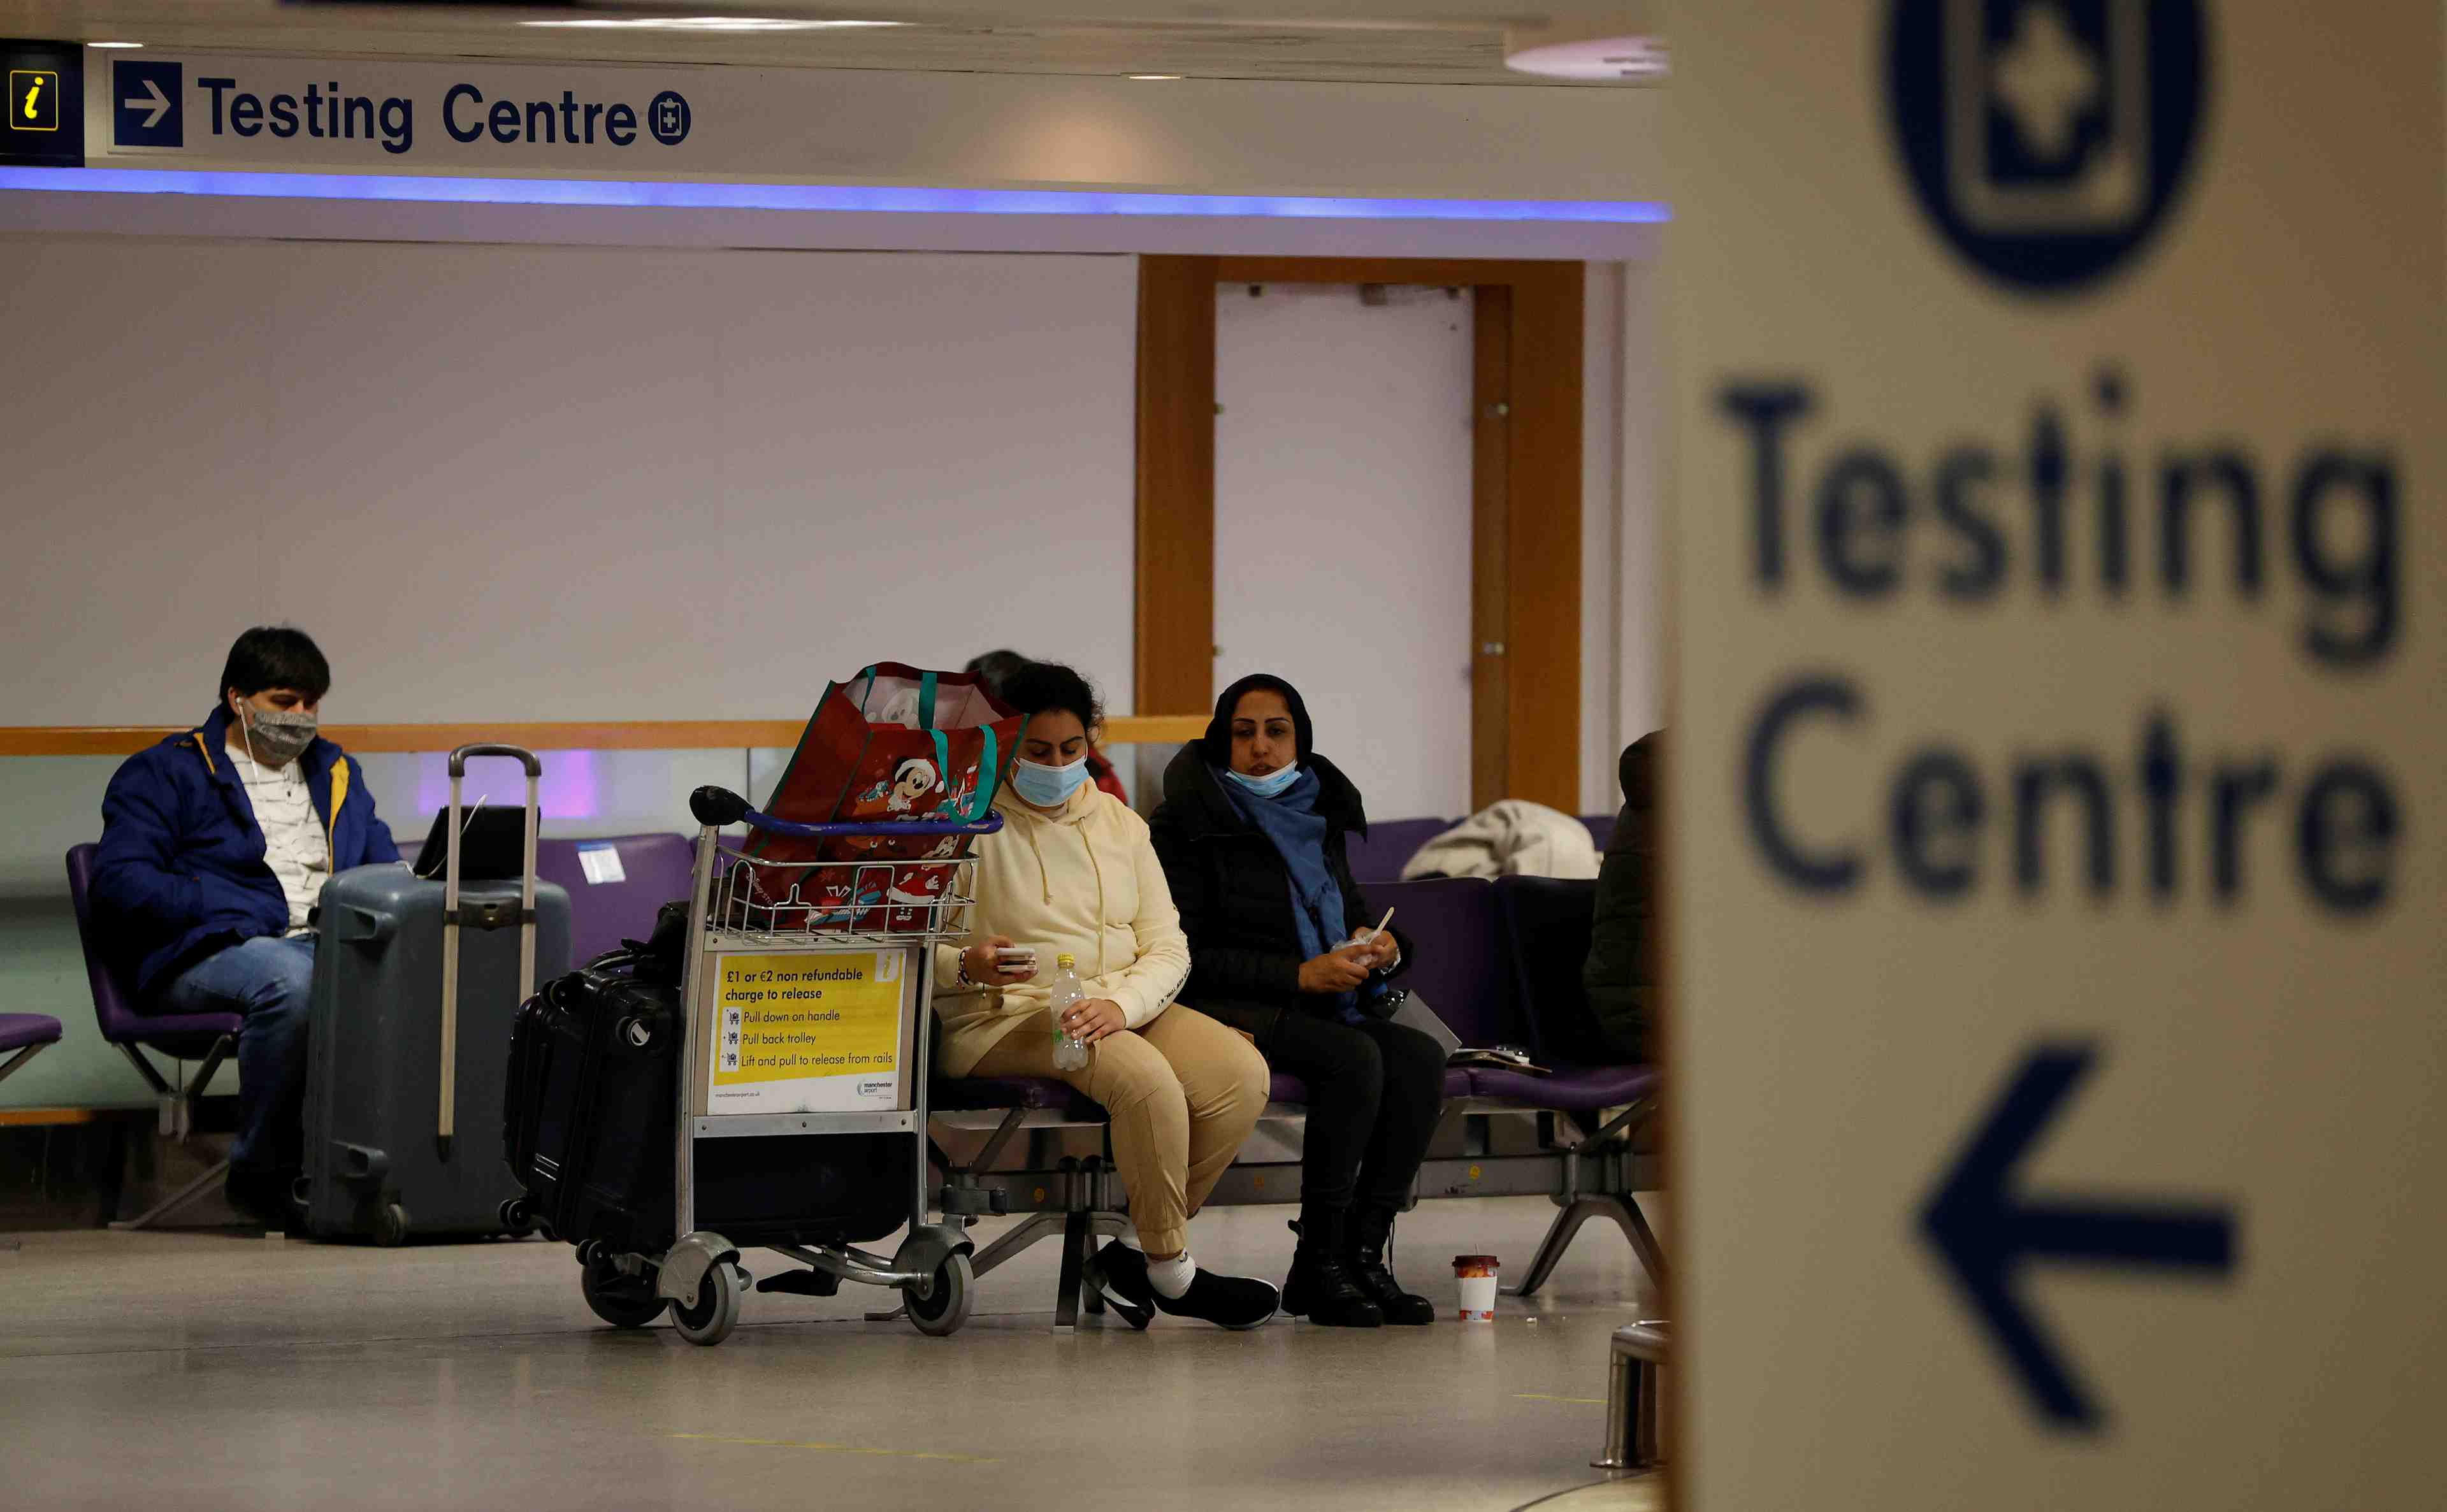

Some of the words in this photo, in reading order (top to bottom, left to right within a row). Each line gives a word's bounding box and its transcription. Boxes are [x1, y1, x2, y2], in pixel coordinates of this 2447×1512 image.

[197, 77, 413, 154] Testing
[442, 83, 639, 147] Centre
[1717, 366, 2404, 669] Testing
[1741, 672, 2402, 919] Centre
[726, 970, 740, 983] £1
[744, 972, 756, 982] or
[760, 970, 773, 982] €2
[777, 972, 798, 982] non
[802, 968, 863, 981] refundable
[725, 989, 764, 1002] charge
[767, 990, 778, 1000] to
[781, 988, 823, 999] release
[744, 1012, 760, 1023] Pull
[763, 1011, 789, 1023] down
[792, 1013, 804, 1022] on
[807, 1009, 841, 1021] handle
[742, 1034, 759, 1045] Pull
[762, 1033, 784, 1044] back
[787, 1031, 816, 1045] trolley
[741, 1056, 756, 1067] Lift
[758, 1056, 776, 1067] and
[779, 1055, 797, 1068] pull
[799, 1055, 809, 1065] to
[811, 1053, 846, 1065] release
[848, 1053, 870, 1064] from
[873, 1053, 893, 1063] rails
